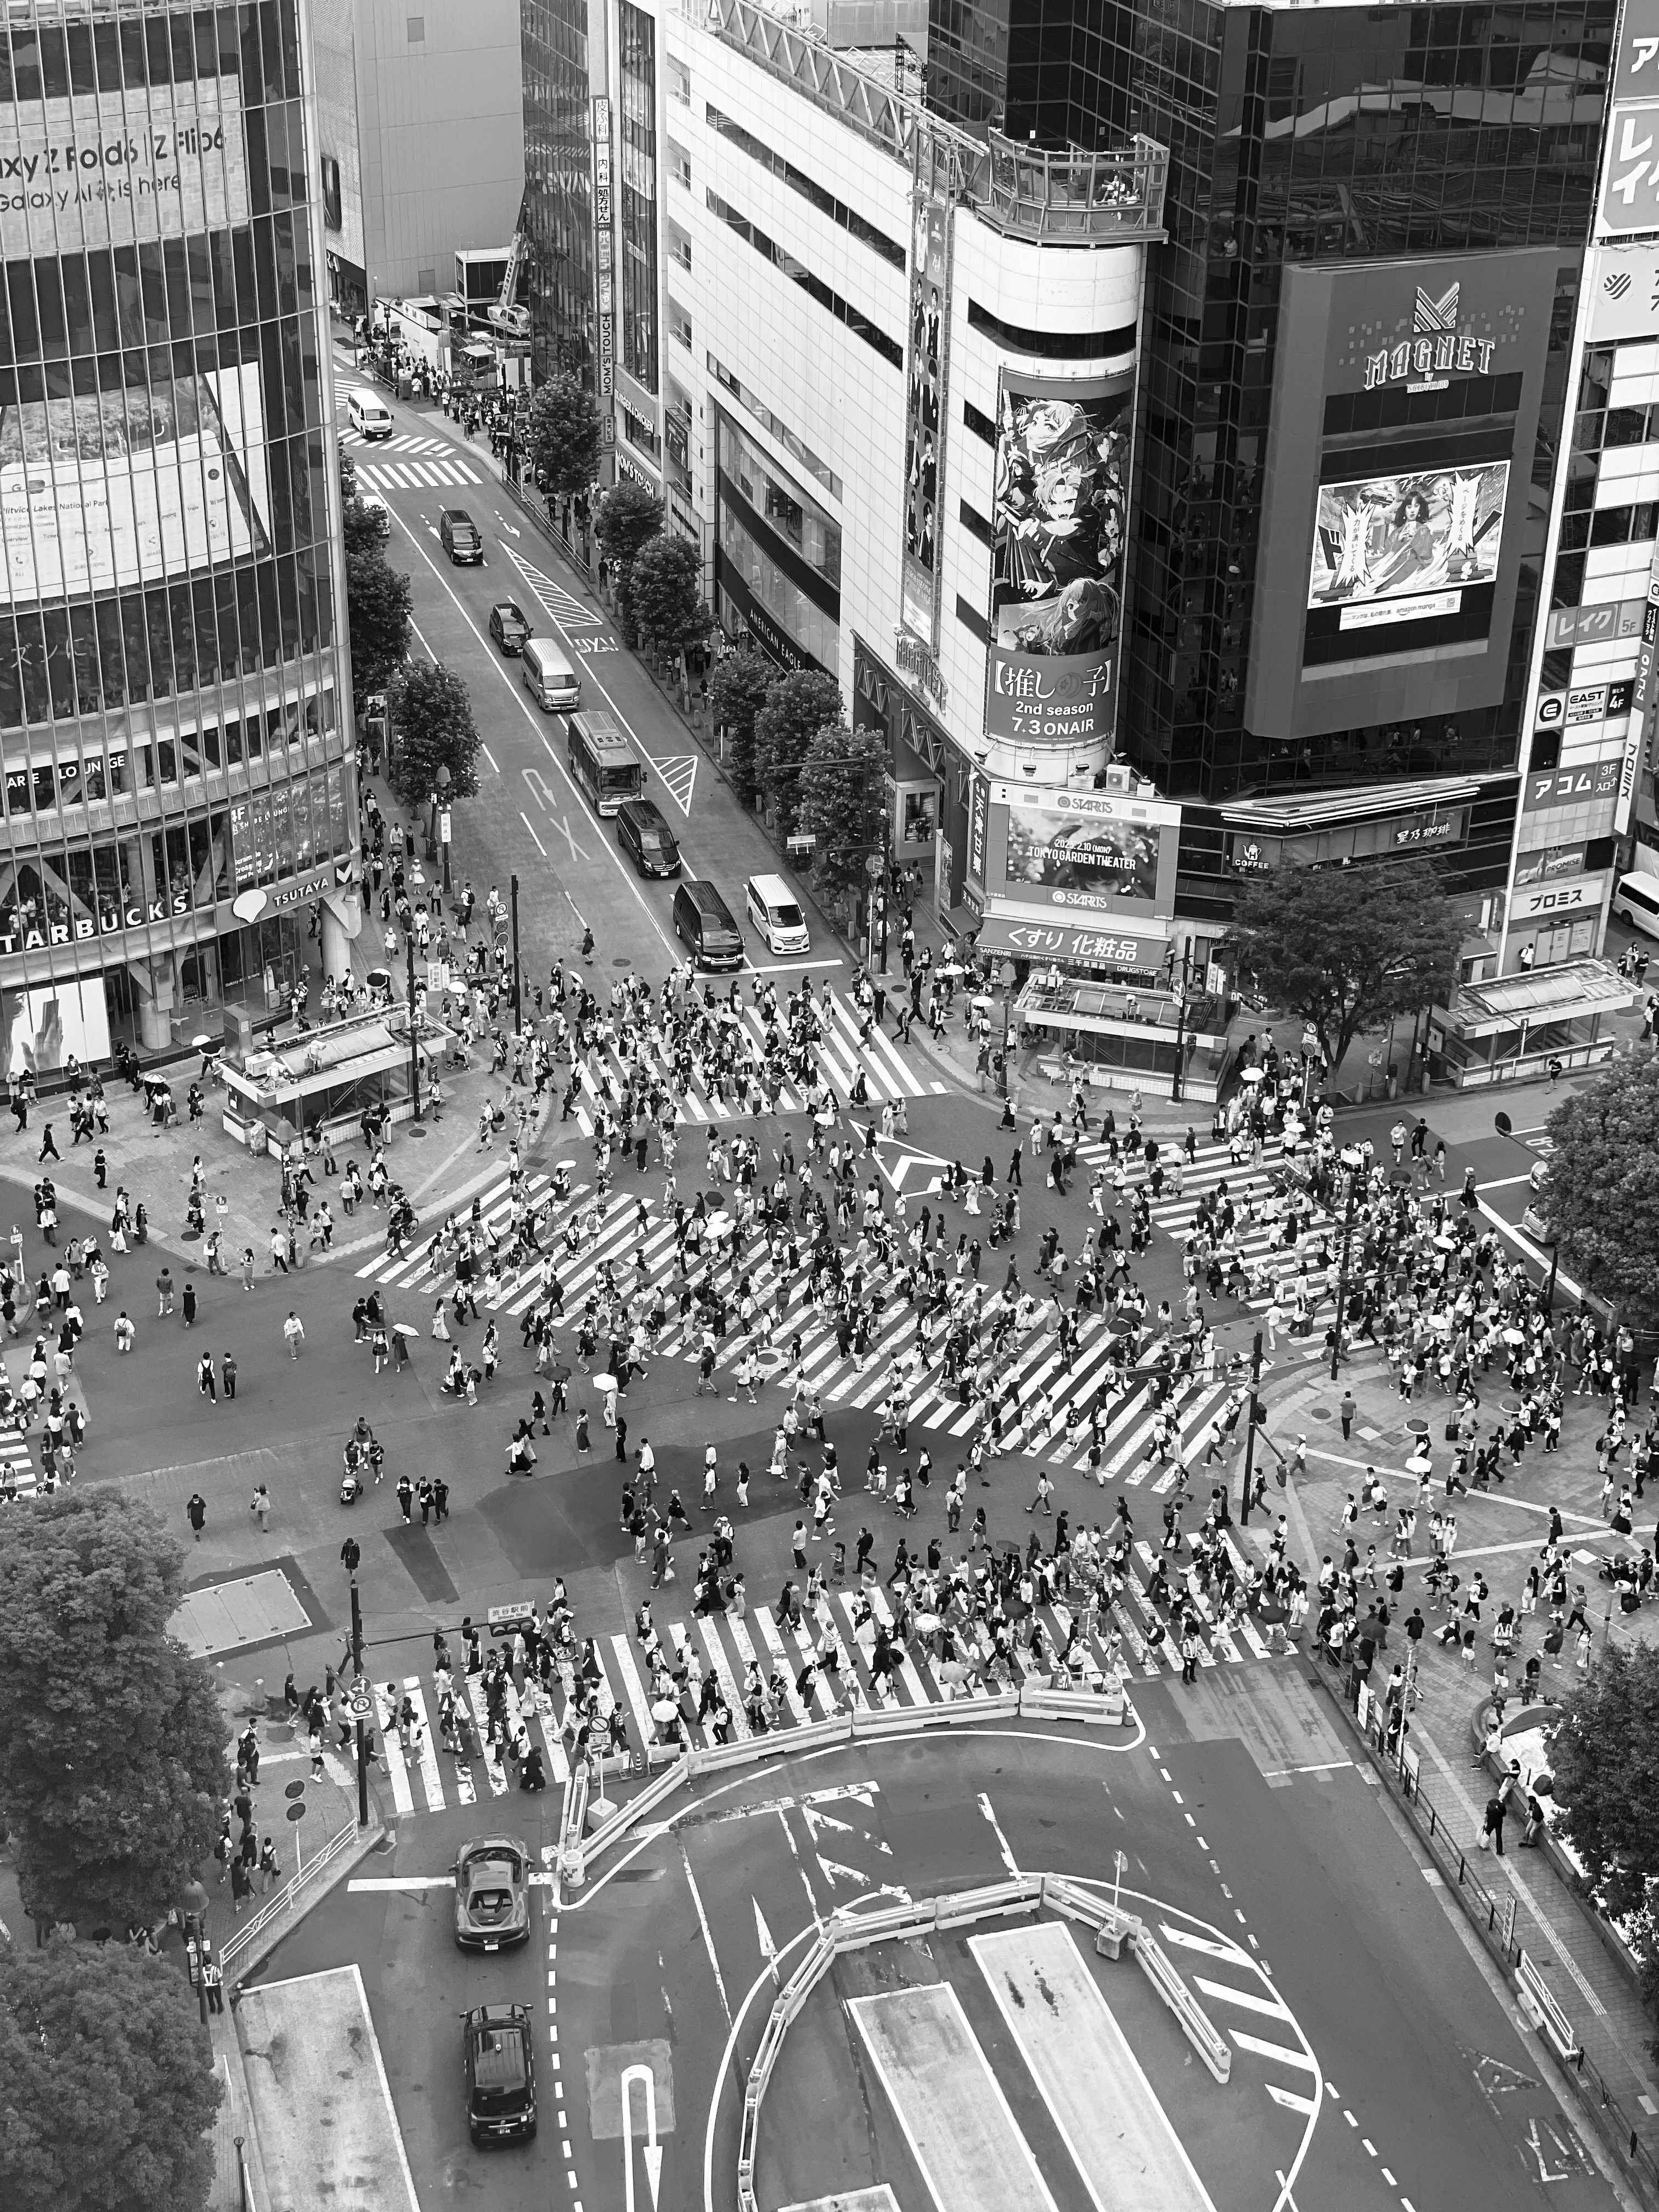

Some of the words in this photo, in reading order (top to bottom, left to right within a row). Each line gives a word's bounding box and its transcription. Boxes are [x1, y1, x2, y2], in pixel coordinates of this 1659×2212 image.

[597, 100, 607, 136] 皮ふ科
[154, 134, 168, 160] Z
[599, 159, 608, 183] 内科
[138, 176, 180, 196] here
[598, 189, 608, 221] 処方せん
[603, 315, 611, 354] TOUCH
[1364, 336, 1496, 391] MAGNET
[603, 357, 612, 394] MOM'S
[59, 499, 92, 510] Natioal
[749, 608, 779, 650] AMERICAN
[1558, 609, 1612, 637] レイク
[1621, 619, 1636, 633] 5F
[1570, 690, 1605, 704] EAST
[1609, 695, 1624, 709] 4F
[1015, 701, 1042, 716] 2nd
[1046, 702, 1093, 716] season
[58, 755, 125, 780] LOUNGE
[1601, 763, 1617, 776] 3F
[1621, 743, 1638, 800] プロミス
[1535, 772, 1592, 800] アコム
[1595, 782, 1610, 793] 入口
[231, 806, 245, 822] 4F
[240, 815, 263, 830] SHRE
[1397, 822, 1451, 844] 星乃珈琲
[235, 850, 262, 866] Scramle
[235, 860, 263, 874] Crossng
[1028, 845, 1059, 860] TOKYO
[1059, 850, 1096, 865] GARDEN
[1096, 854, 1136, 870] THEATER
[1235, 859, 1269, 869] COFFEE
[1546, 856, 1582, 873] PROMISE
[274, 877, 329, 906] TSUTAYA
[1066, 893, 1108, 909] STARTS
[1530, 889, 1583, 912] プロミス
[979, 947, 1012, 957] SANZENRI
[1008, 927, 1065, 951] くすり
[1071, 934, 1138, 962] 化粧品
[1116, 965, 1159, 977] DRUGSTORE
